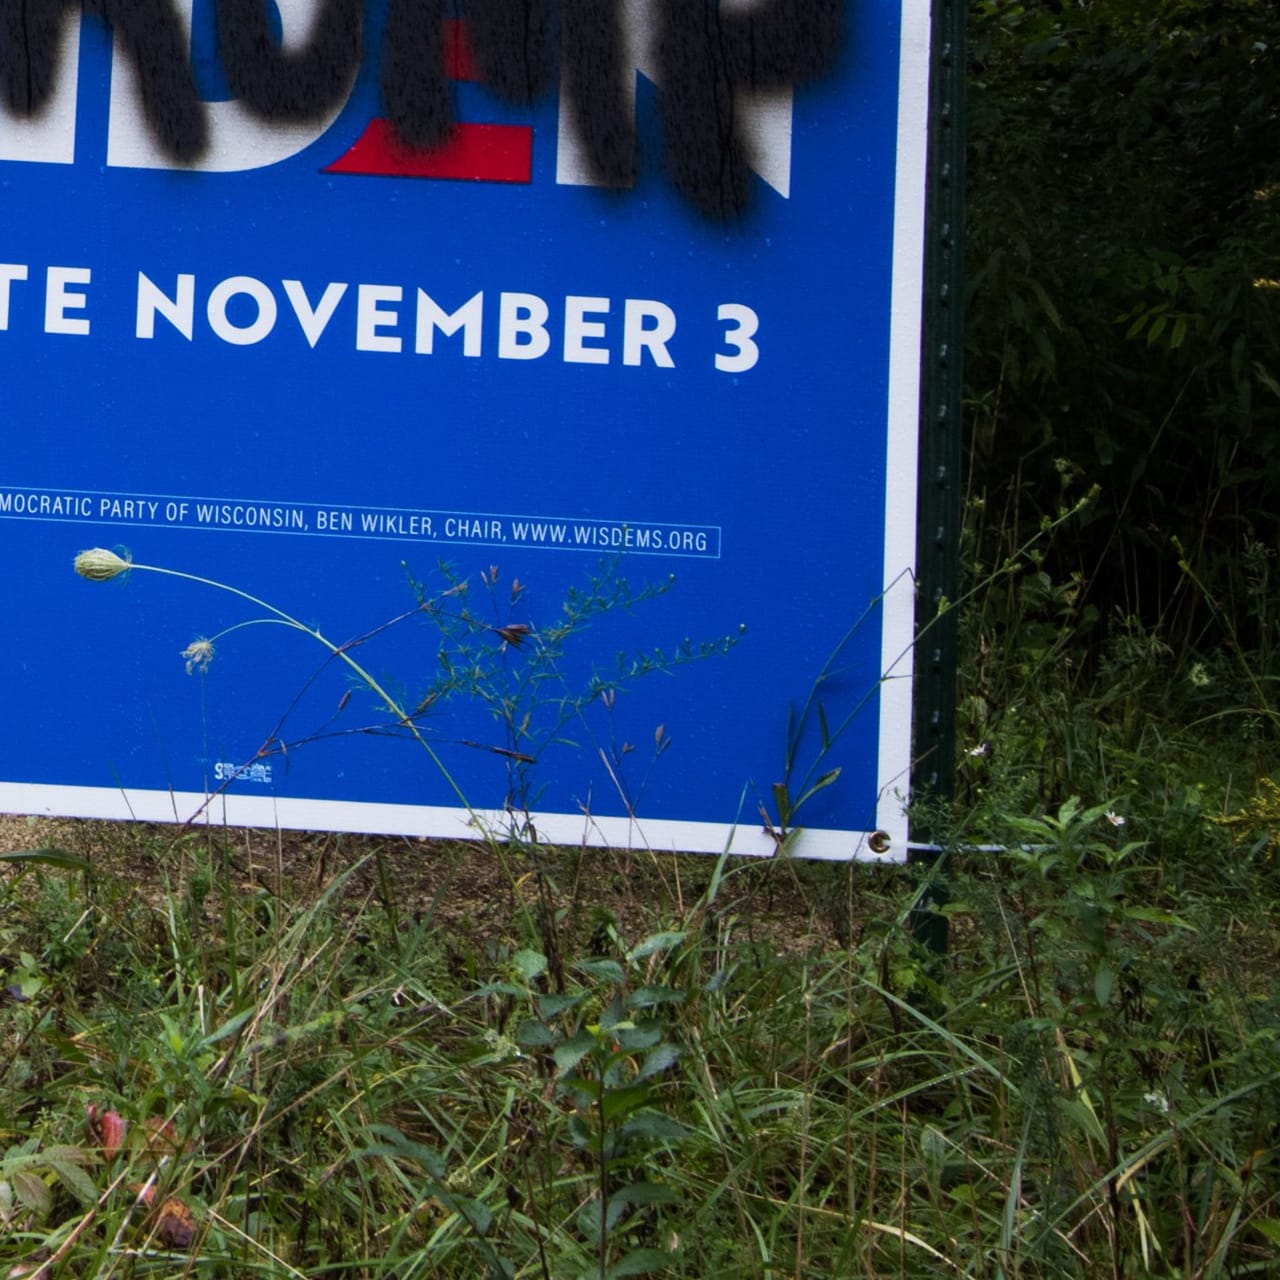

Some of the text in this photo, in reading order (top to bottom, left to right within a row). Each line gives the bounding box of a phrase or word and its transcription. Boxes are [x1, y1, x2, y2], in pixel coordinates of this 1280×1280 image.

[136, 271, 676, 368] NOVEMBER
[714, 304, 759, 372] 3
[100, 498, 158, 520] PARTY
[165, 502, 189, 521] OF
[196, 504, 309, 530] WISCONSIN,
[316, 511, 353, 531] BEN
[361, 514, 437, 539] WIKLER,
[445, 518, 507, 542] CHAIR,
[511, 522, 708, 551] WWW.WISDEMS.ORG
